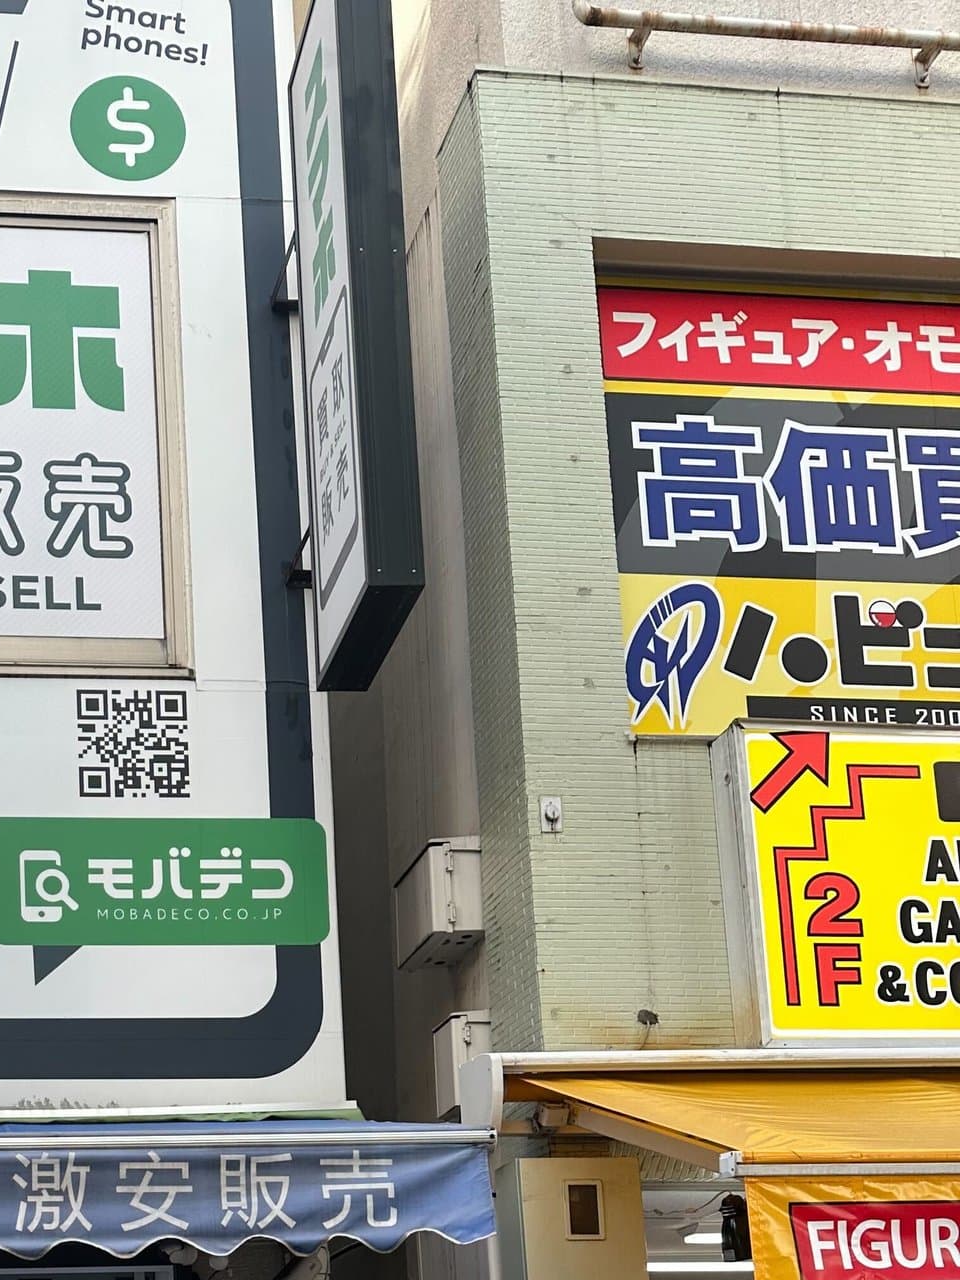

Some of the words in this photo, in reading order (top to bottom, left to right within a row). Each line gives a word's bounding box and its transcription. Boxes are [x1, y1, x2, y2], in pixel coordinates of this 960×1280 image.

[85, 0, 186, 34] Smart
[81, 25, 208, 66] phones!
[811, 704, 898, 724] SINCE
[88, 847, 294, 900] モバデコ
[925, 839, 960, 882] A
[97, 908, 283, 921] MOBADECO.CO.JP
[804, 871, 865, 1007] 2F
[12, 1150, 399, 1234] 激安販売
[807, 1218, 960, 1270] FIGUR
